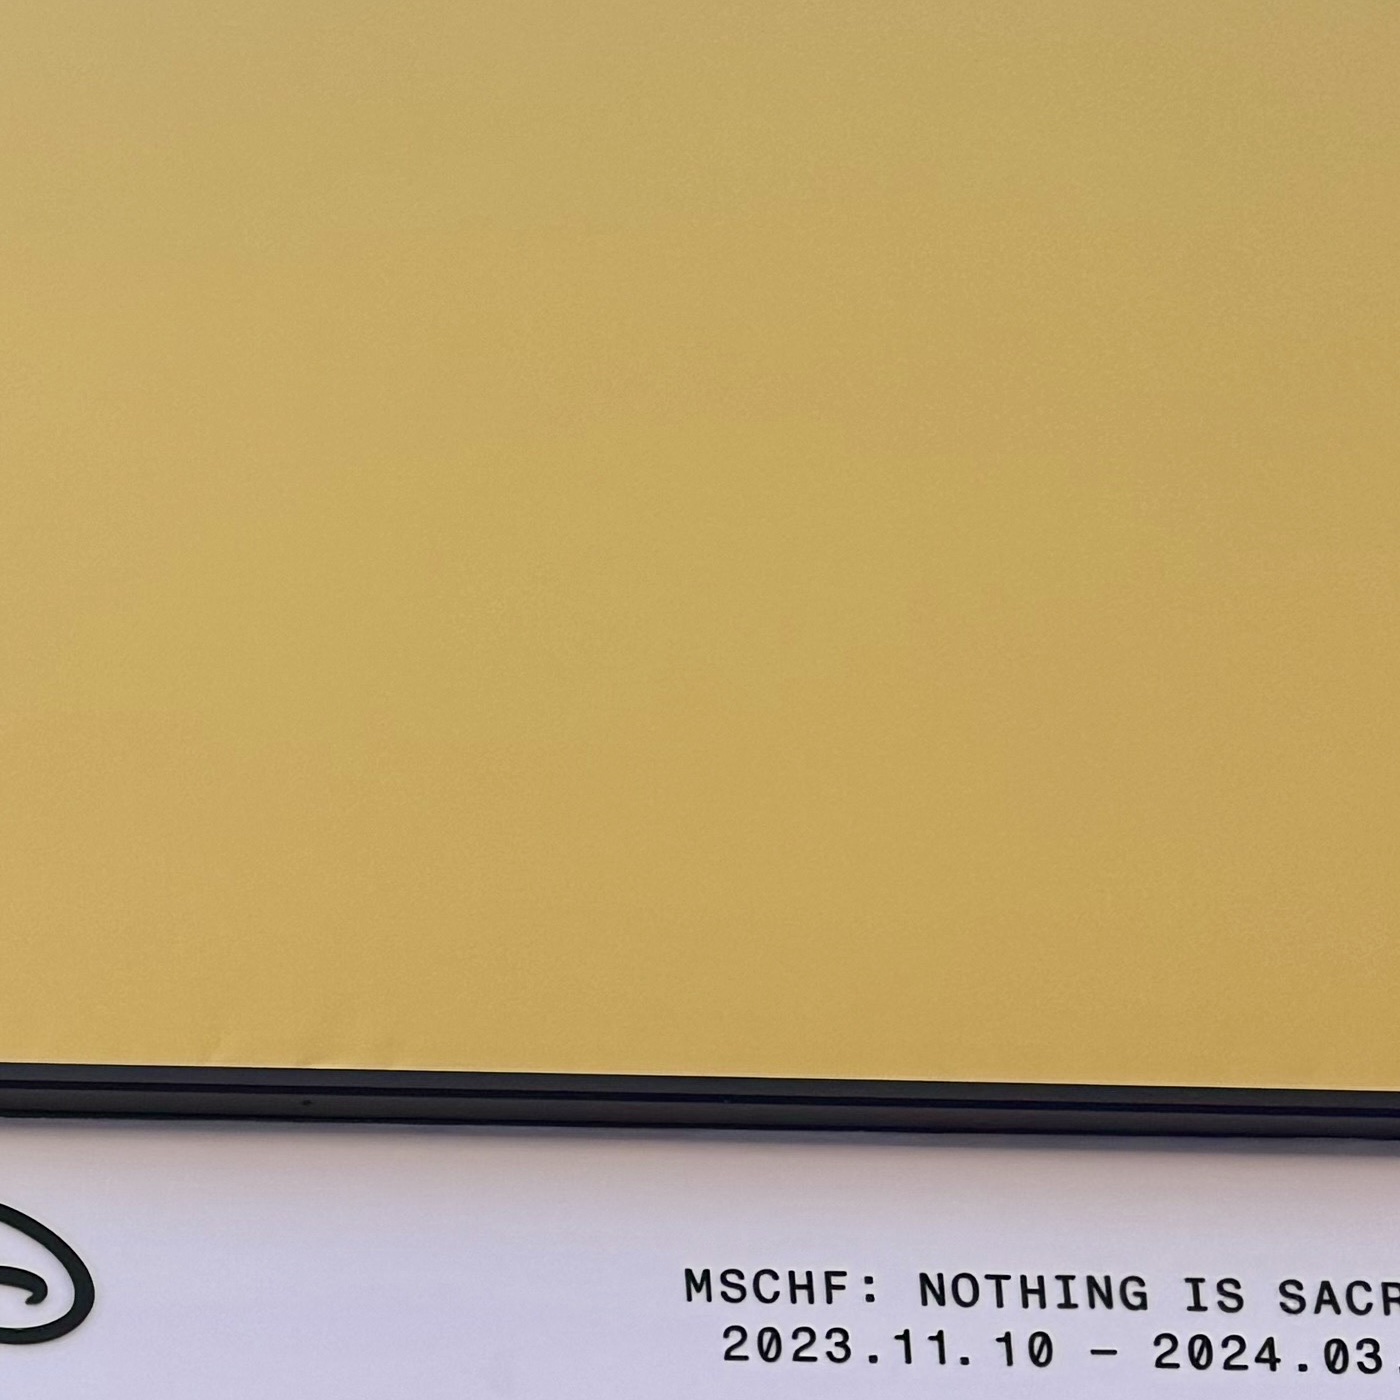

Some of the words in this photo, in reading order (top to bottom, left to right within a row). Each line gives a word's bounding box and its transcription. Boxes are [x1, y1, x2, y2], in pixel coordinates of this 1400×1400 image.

[684, 1268, 876, 1304] MSCHF:
[919, 1271, 1149, 1312] NOTHING
[1185, 1276, 1245, 1314] IS
[722, 1326, 1054, 1367] 2023.11.10
[1153, 1331, 1400, 1375] 2024.03
